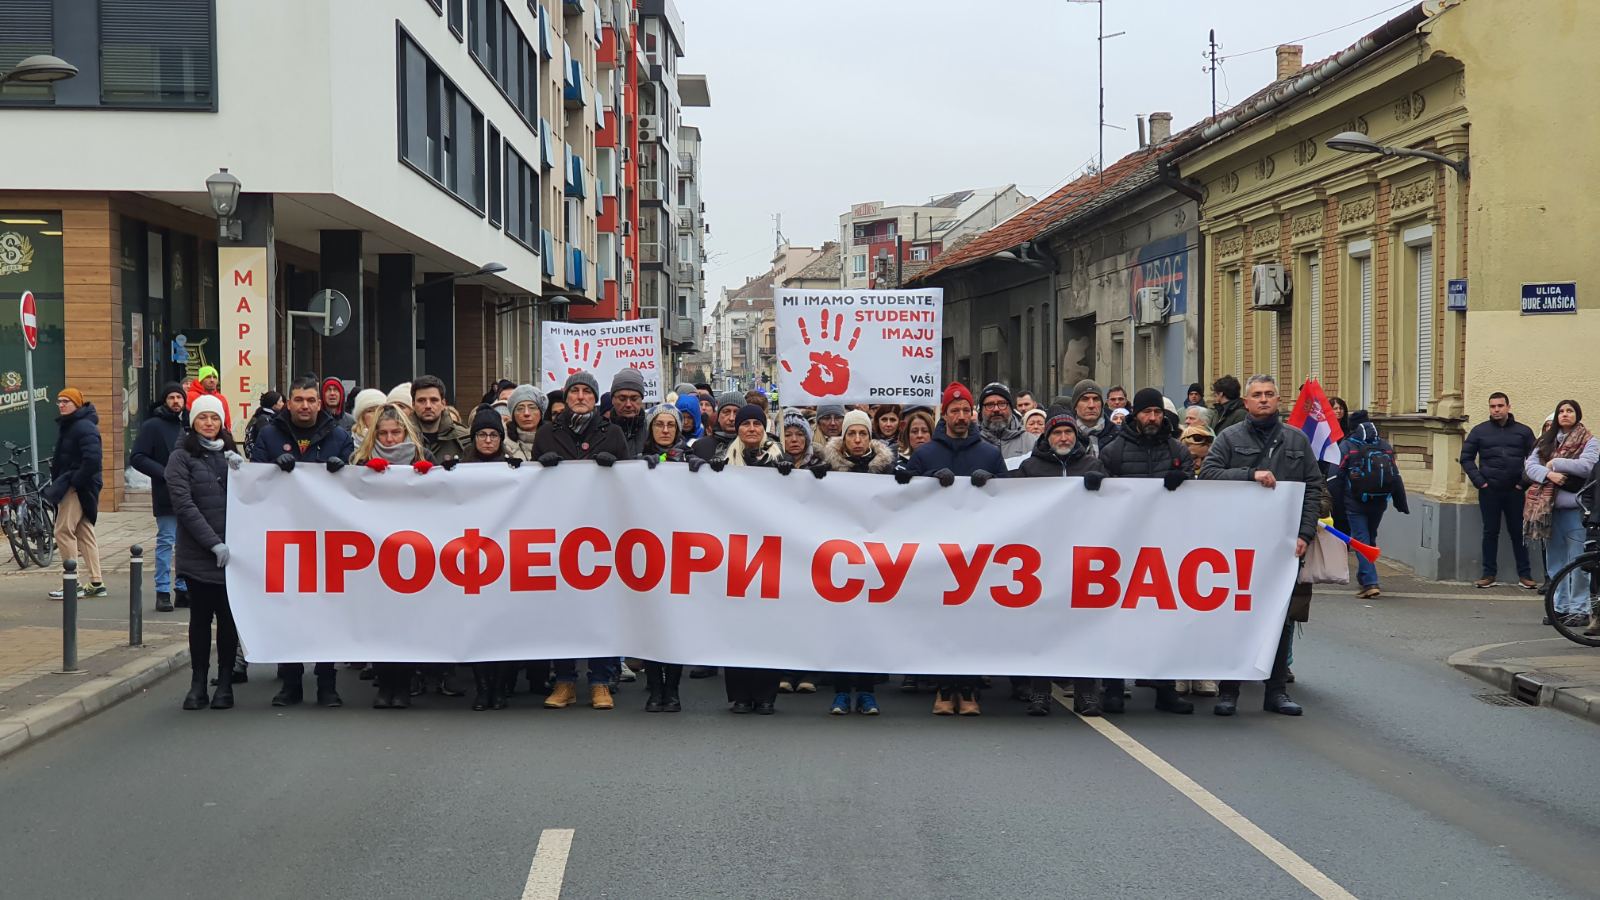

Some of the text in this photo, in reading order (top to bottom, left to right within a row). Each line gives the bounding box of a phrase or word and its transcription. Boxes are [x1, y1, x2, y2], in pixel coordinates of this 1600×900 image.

[1536, 286, 1562, 295] ULICA
[783, 295, 936, 307] MI IMAMO STUDENTE,
[855, 310, 935, 323] STUDENTI
[550, 324, 654, 337] MI IMAMO STUDENTE,
[882, 328, 934, 341] IMAJU
[233, 269, 253, 419] МАРКЕТ
[597, 336, 654, 348] STUDENTI
[616, 349, 654, 359] IMAJU
[902, 346, 934, 358] NAS
[630, 360, 655, 370] NAS
[643, 379, 657, 388] AŠI
[910, 372, 934, 385] VAŠI
[870, 387, 934, 398] PROFESORI
[265, 526, 1256, 613] ПРОФЕСОРИ СУ УЗ ВАС!
